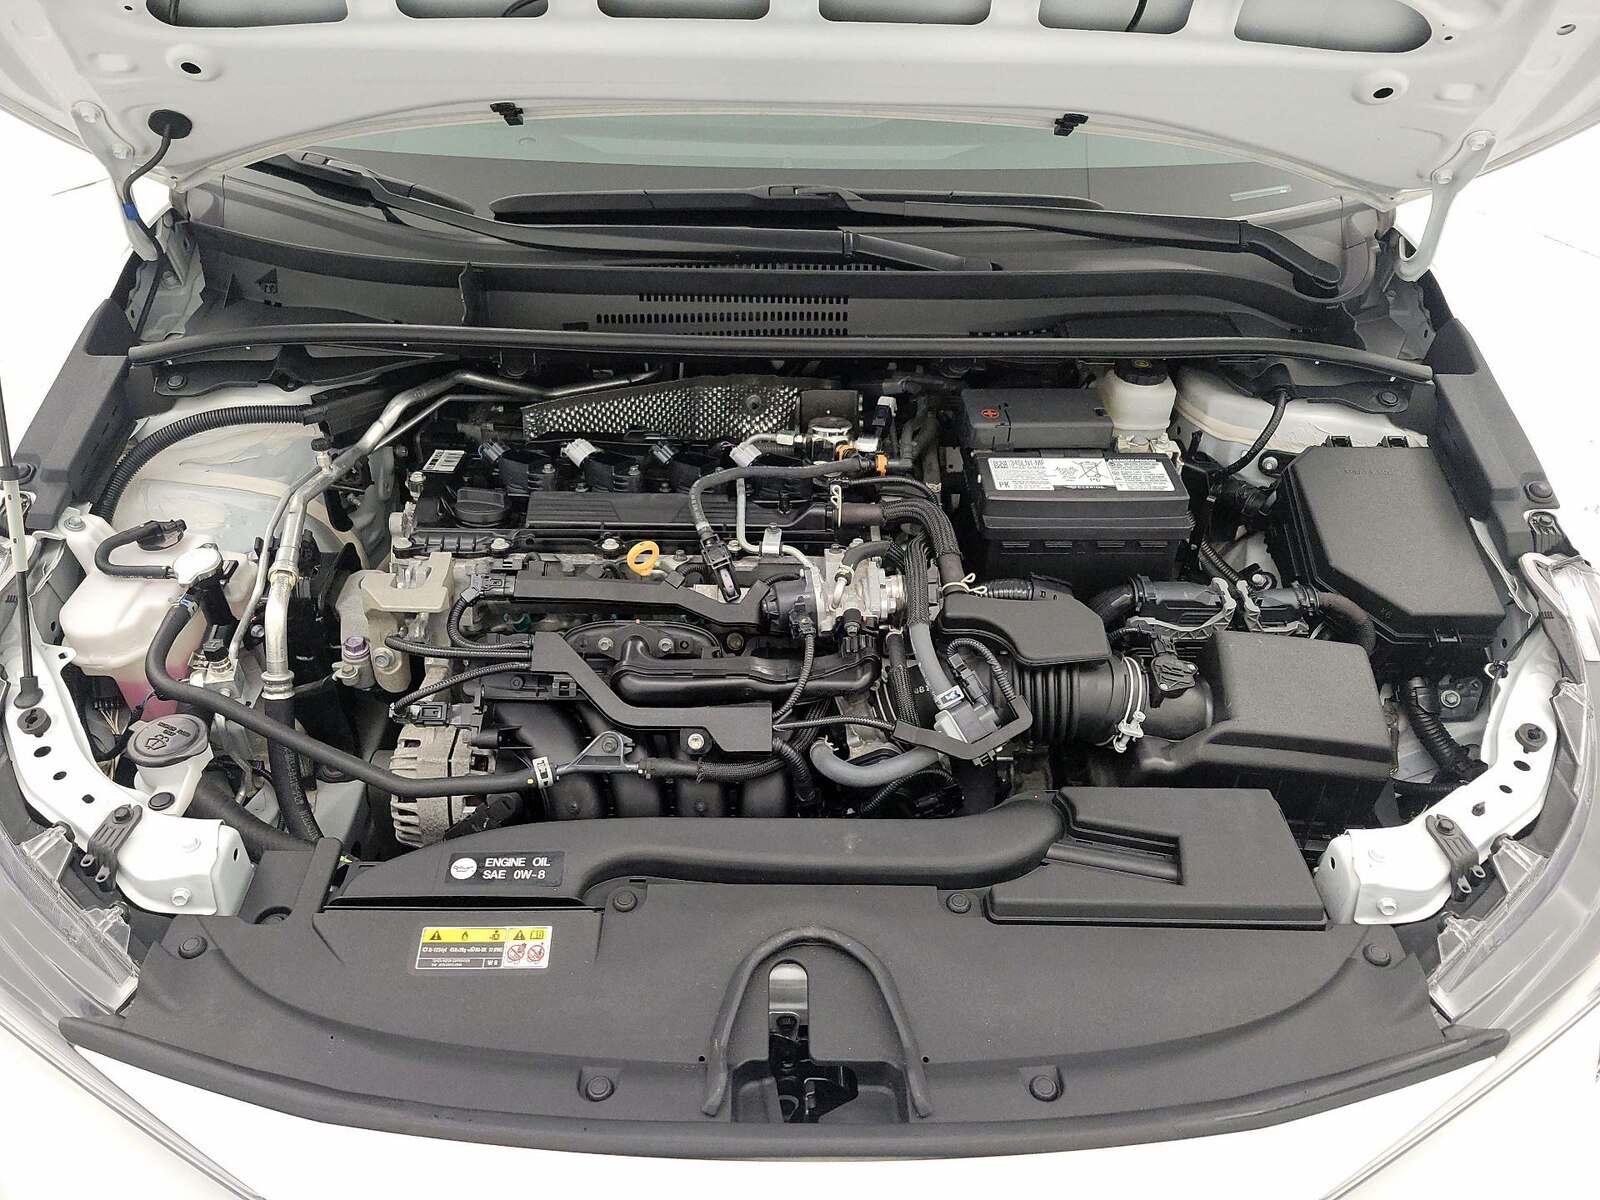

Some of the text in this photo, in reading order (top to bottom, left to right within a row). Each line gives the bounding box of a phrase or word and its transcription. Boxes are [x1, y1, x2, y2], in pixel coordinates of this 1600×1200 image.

[484, 857, 551, 867] ENGINE OIL
[482, 869, 546, 880] SAE 0W-8
